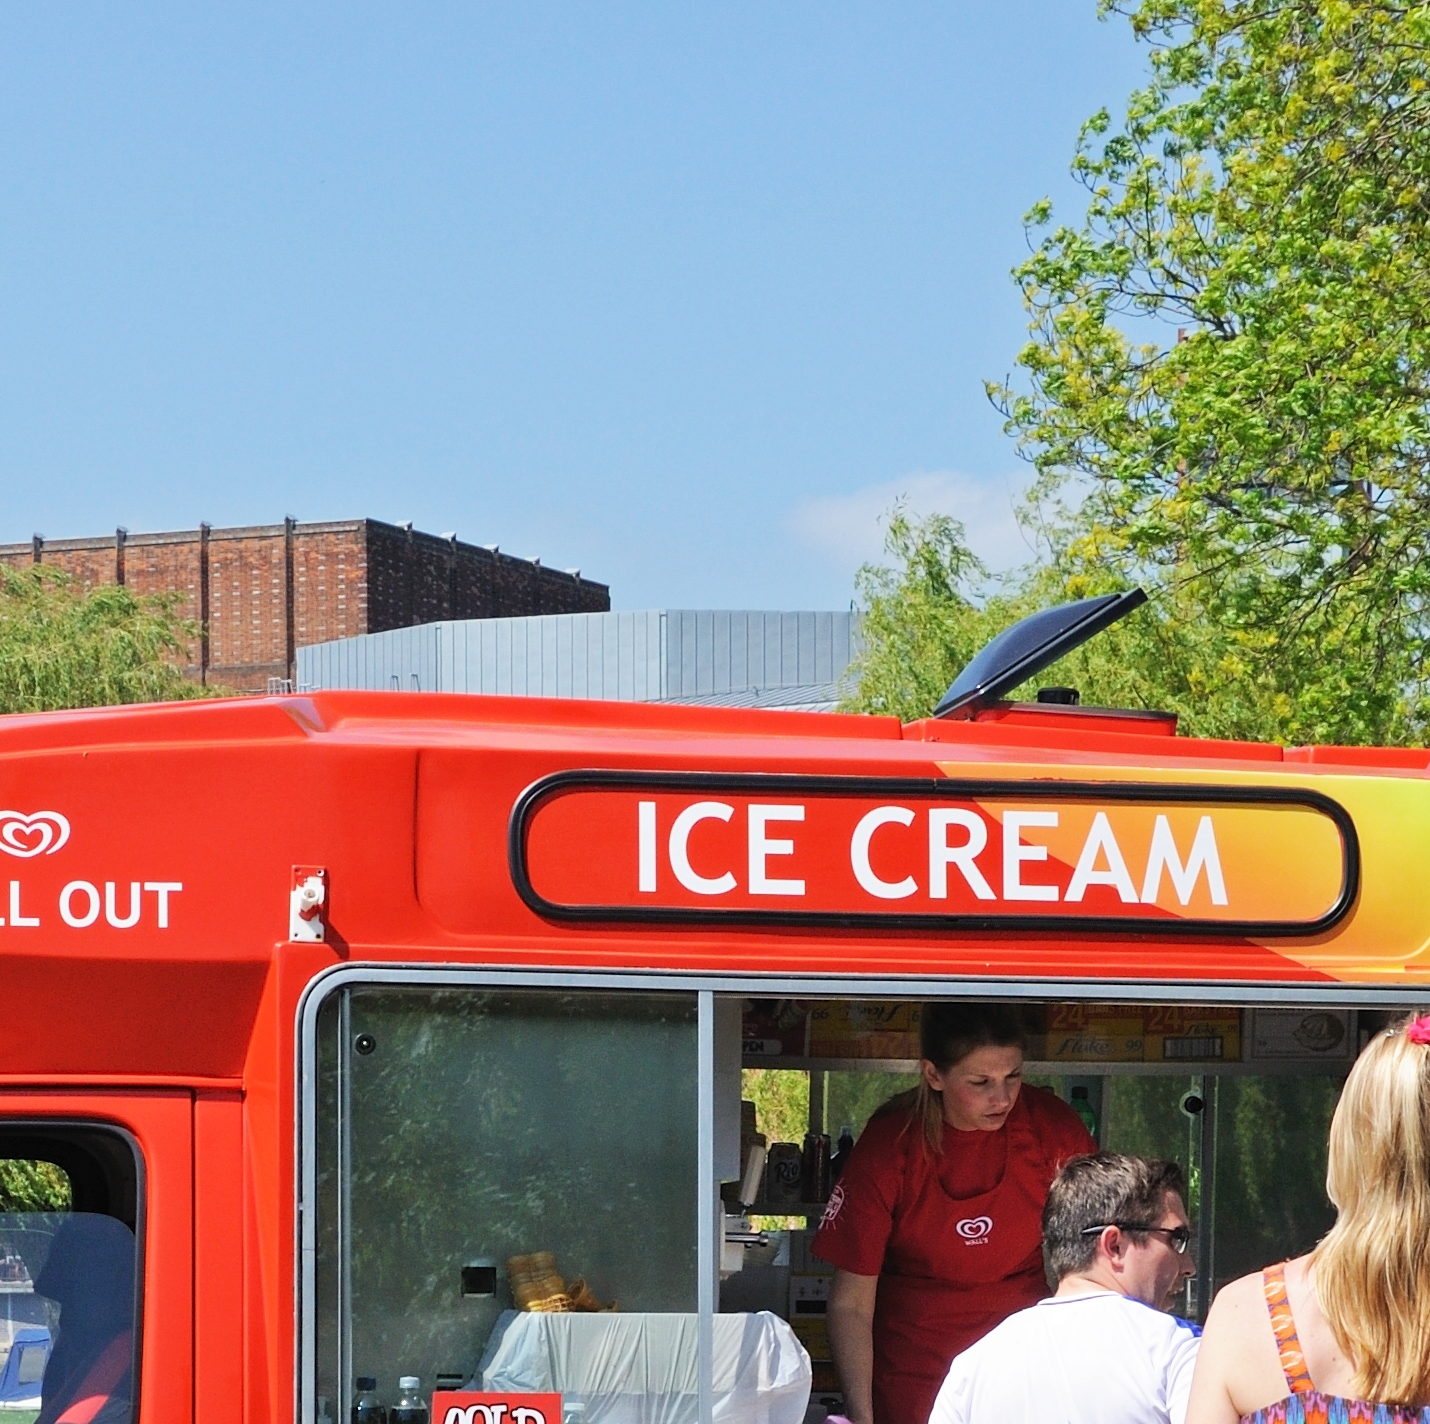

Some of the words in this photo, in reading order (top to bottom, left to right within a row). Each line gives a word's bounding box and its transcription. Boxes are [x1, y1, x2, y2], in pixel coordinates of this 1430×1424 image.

[638, 800, 806, 896] ICE
[850, 805, 1229, 906] CREAM
[58, 880, 183, 929] OUT
[742, 1041, 764, 1052] PEN
